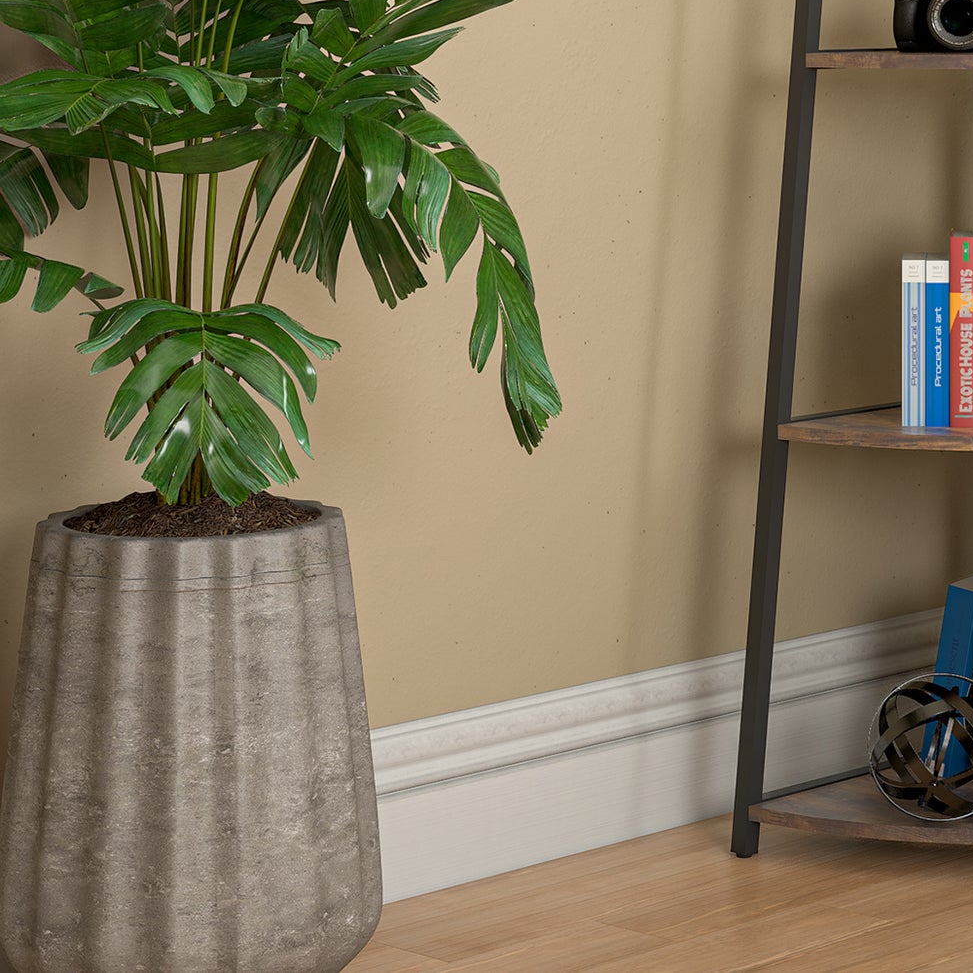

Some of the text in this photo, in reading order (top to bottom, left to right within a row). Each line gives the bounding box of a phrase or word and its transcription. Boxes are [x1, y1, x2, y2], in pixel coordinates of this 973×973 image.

[910, 306, 919, 387] Procedural art
[934, 306, 943, 387] Procedural art
